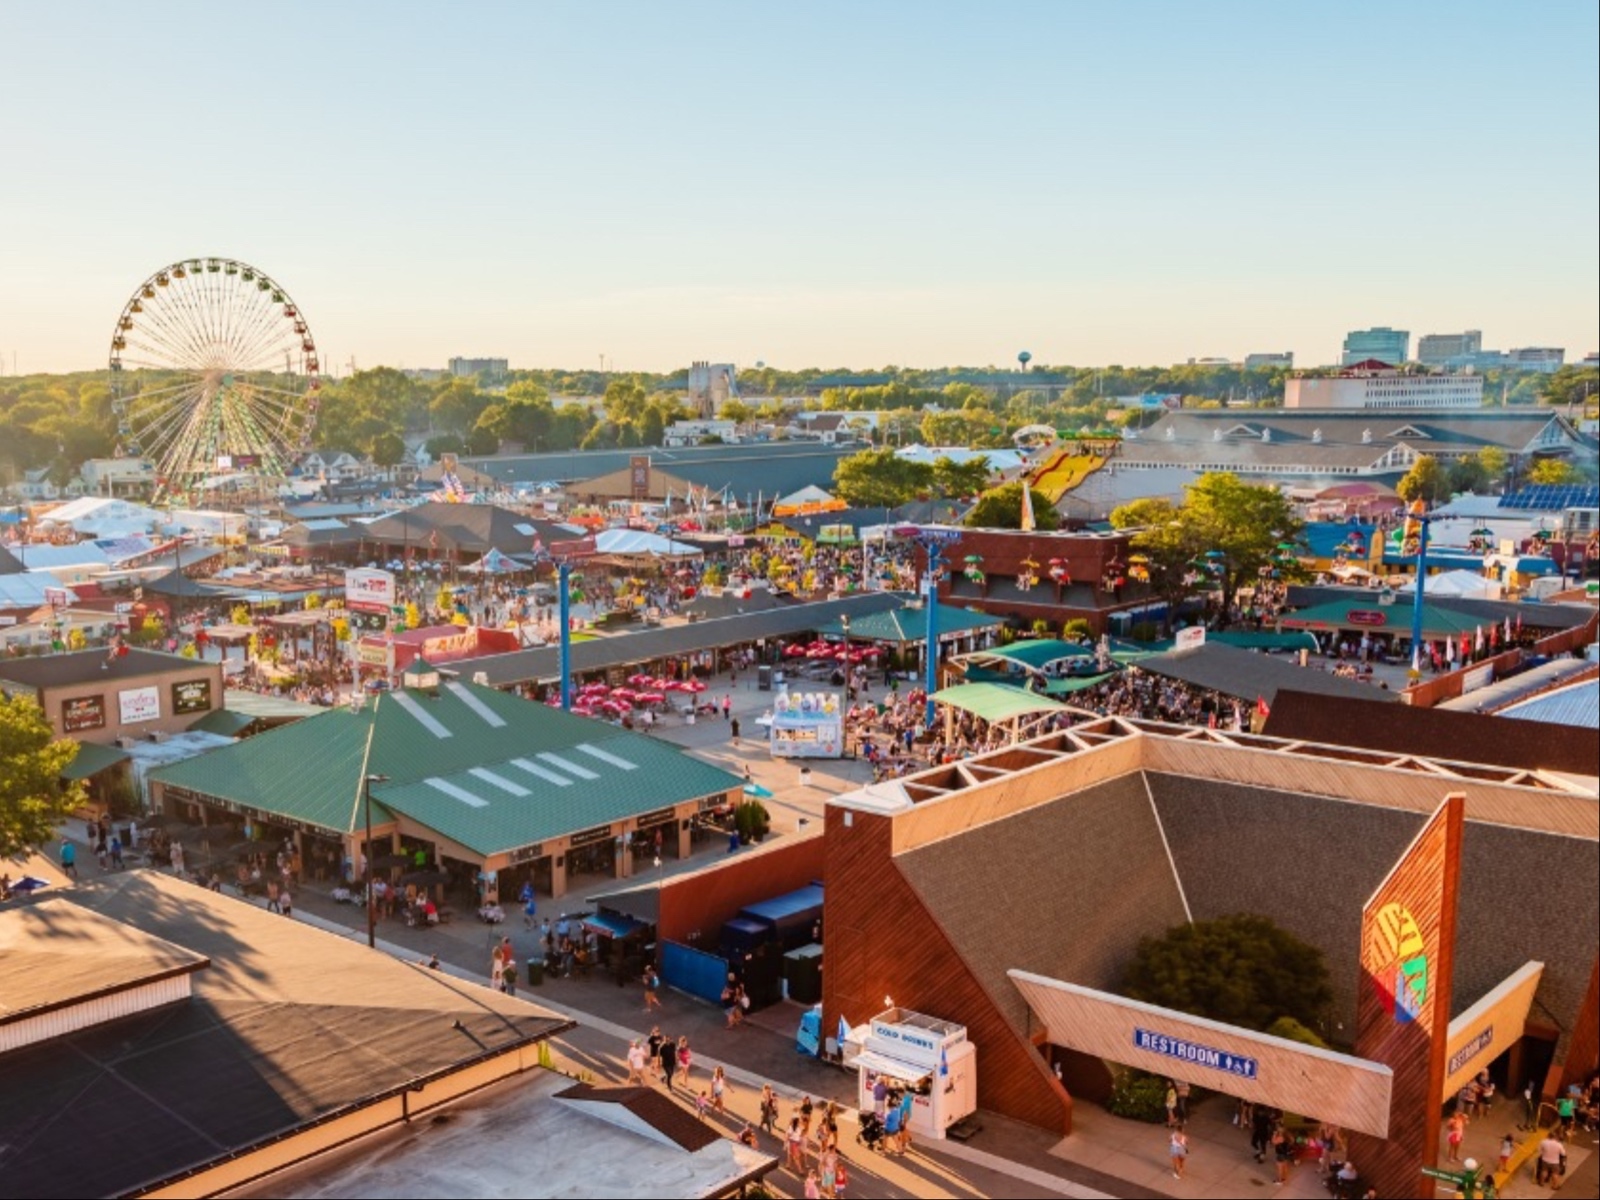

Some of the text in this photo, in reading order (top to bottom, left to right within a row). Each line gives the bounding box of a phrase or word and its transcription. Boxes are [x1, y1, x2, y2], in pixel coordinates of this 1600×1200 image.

[876, 1027, 899, 1039] COLD
[901, 1034, 934, 1050] DRINKS
[1141, 1033, 1220, 1066] RESTROOM
[1450, 1039, 1480, 1073] RESTROOM
